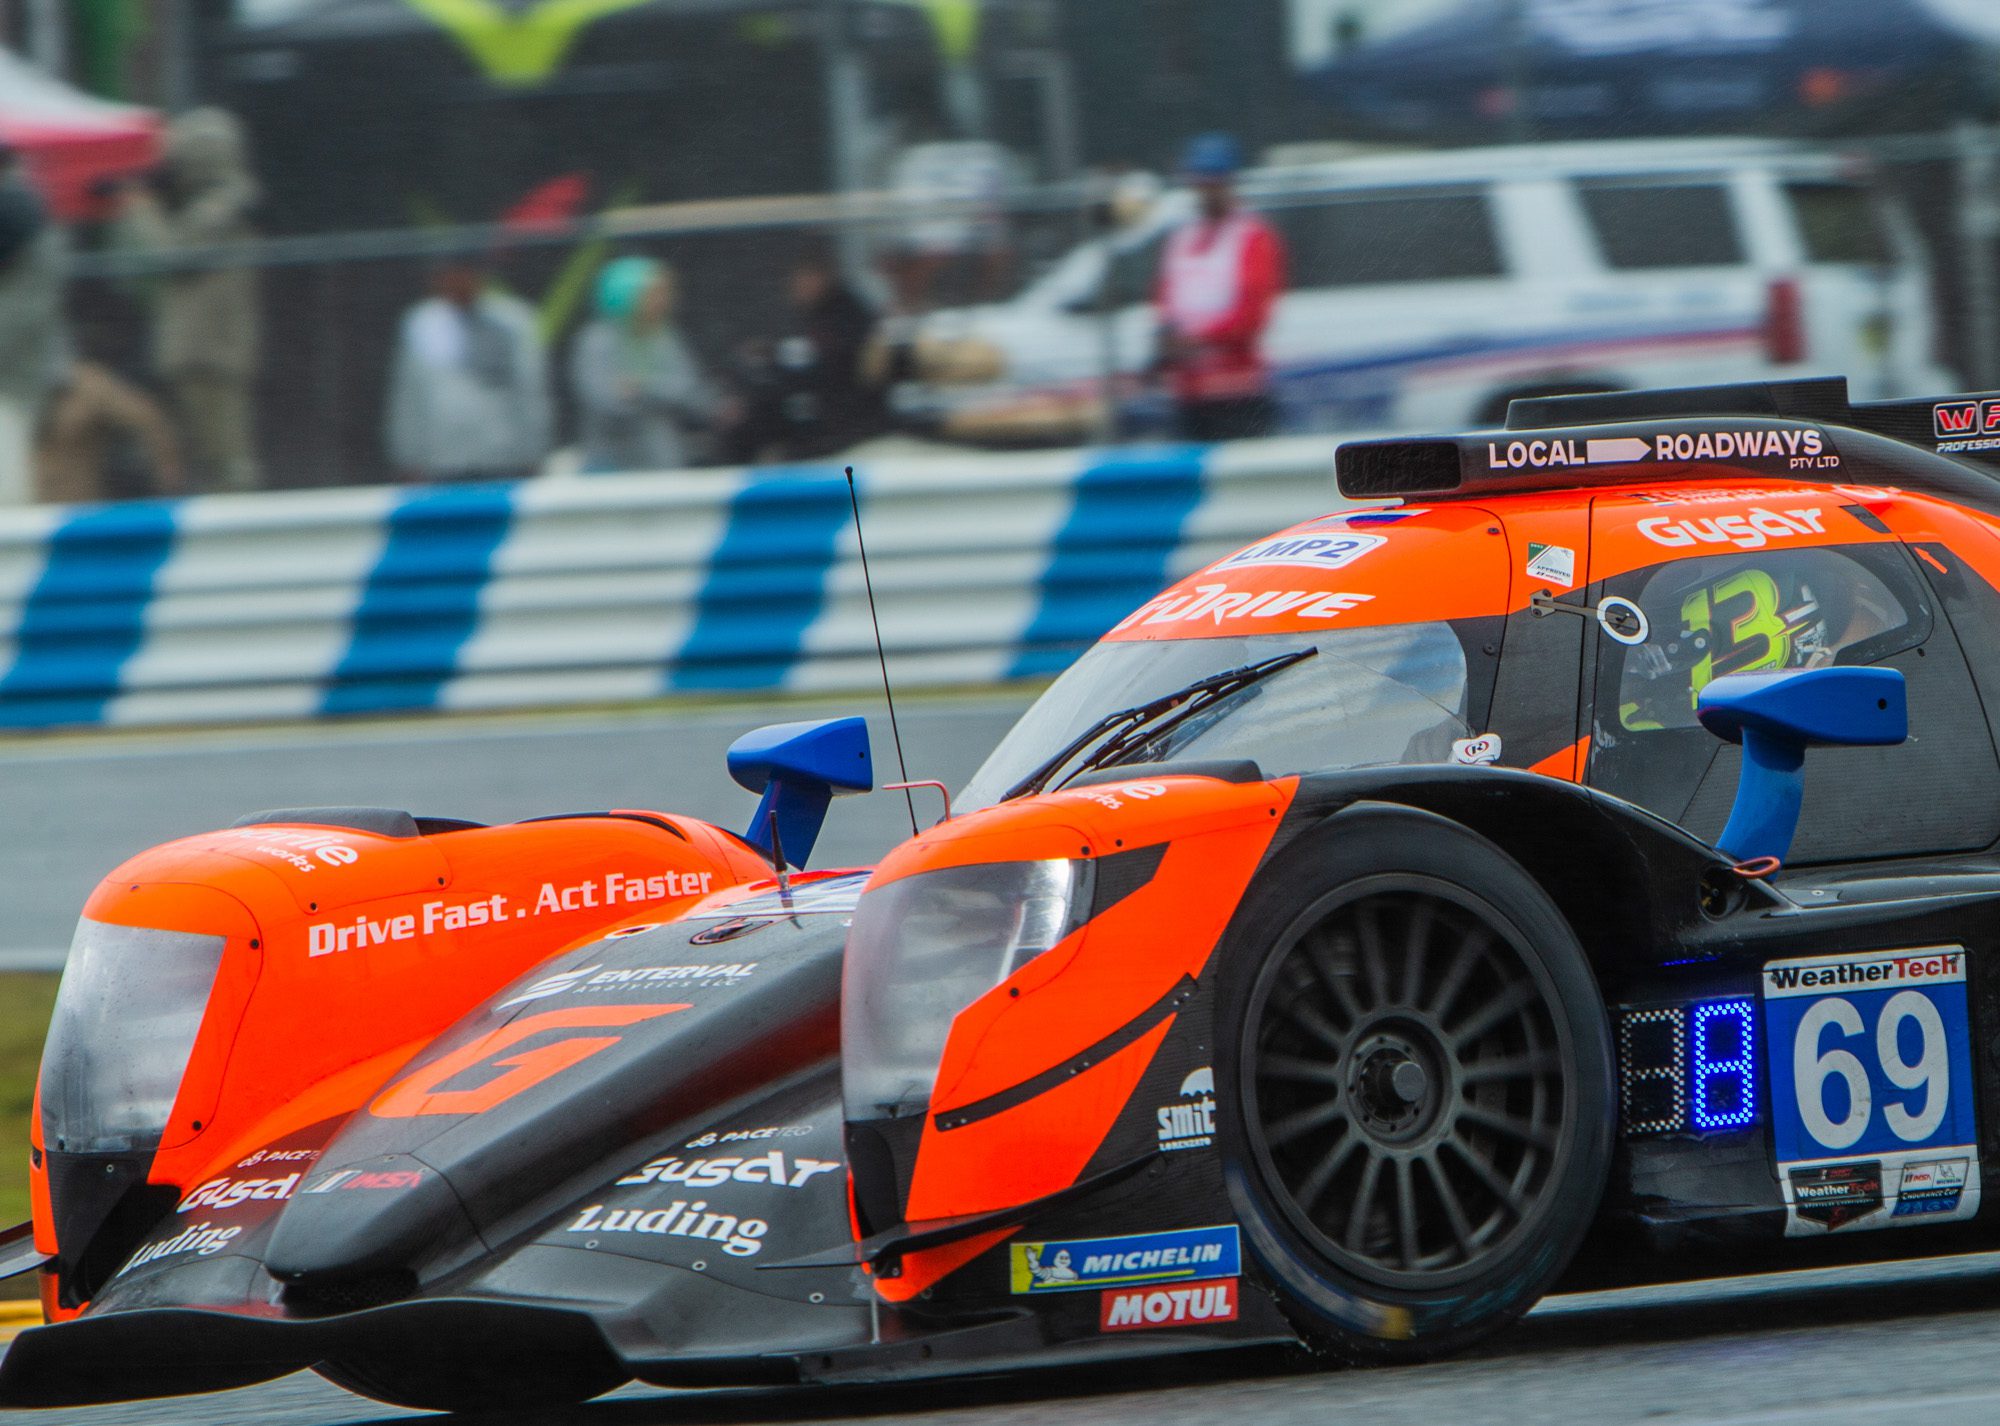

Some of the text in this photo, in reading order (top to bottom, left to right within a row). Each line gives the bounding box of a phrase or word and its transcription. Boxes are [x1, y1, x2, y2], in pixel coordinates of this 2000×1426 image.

[1489, 429, 1824, 469] LOCAL ROADWAYS
[1790, 456, 1840, 470] PTY LTD
[1230, 538, 1360, 563] LMP2
[308, 915, 415, 958] Drive
[422, 894, 510, 935] Fast
[533, 880, 600, 916] Act
[605, 871, 713, 906] Faster
[587, 963, 758, 984] ENTERVAL
[1771, 954, 1961, 989] WeatherTech
[1793, 990, 1950, 1150] 69
[1796, 1180, 1879, 1199] WeatherTech
[567, 1201, 769, 1257] Luding
[1083, 1244, 1222, 1274] MICHELIN
[1107, 1286, 1232, 1327] MOTUL
